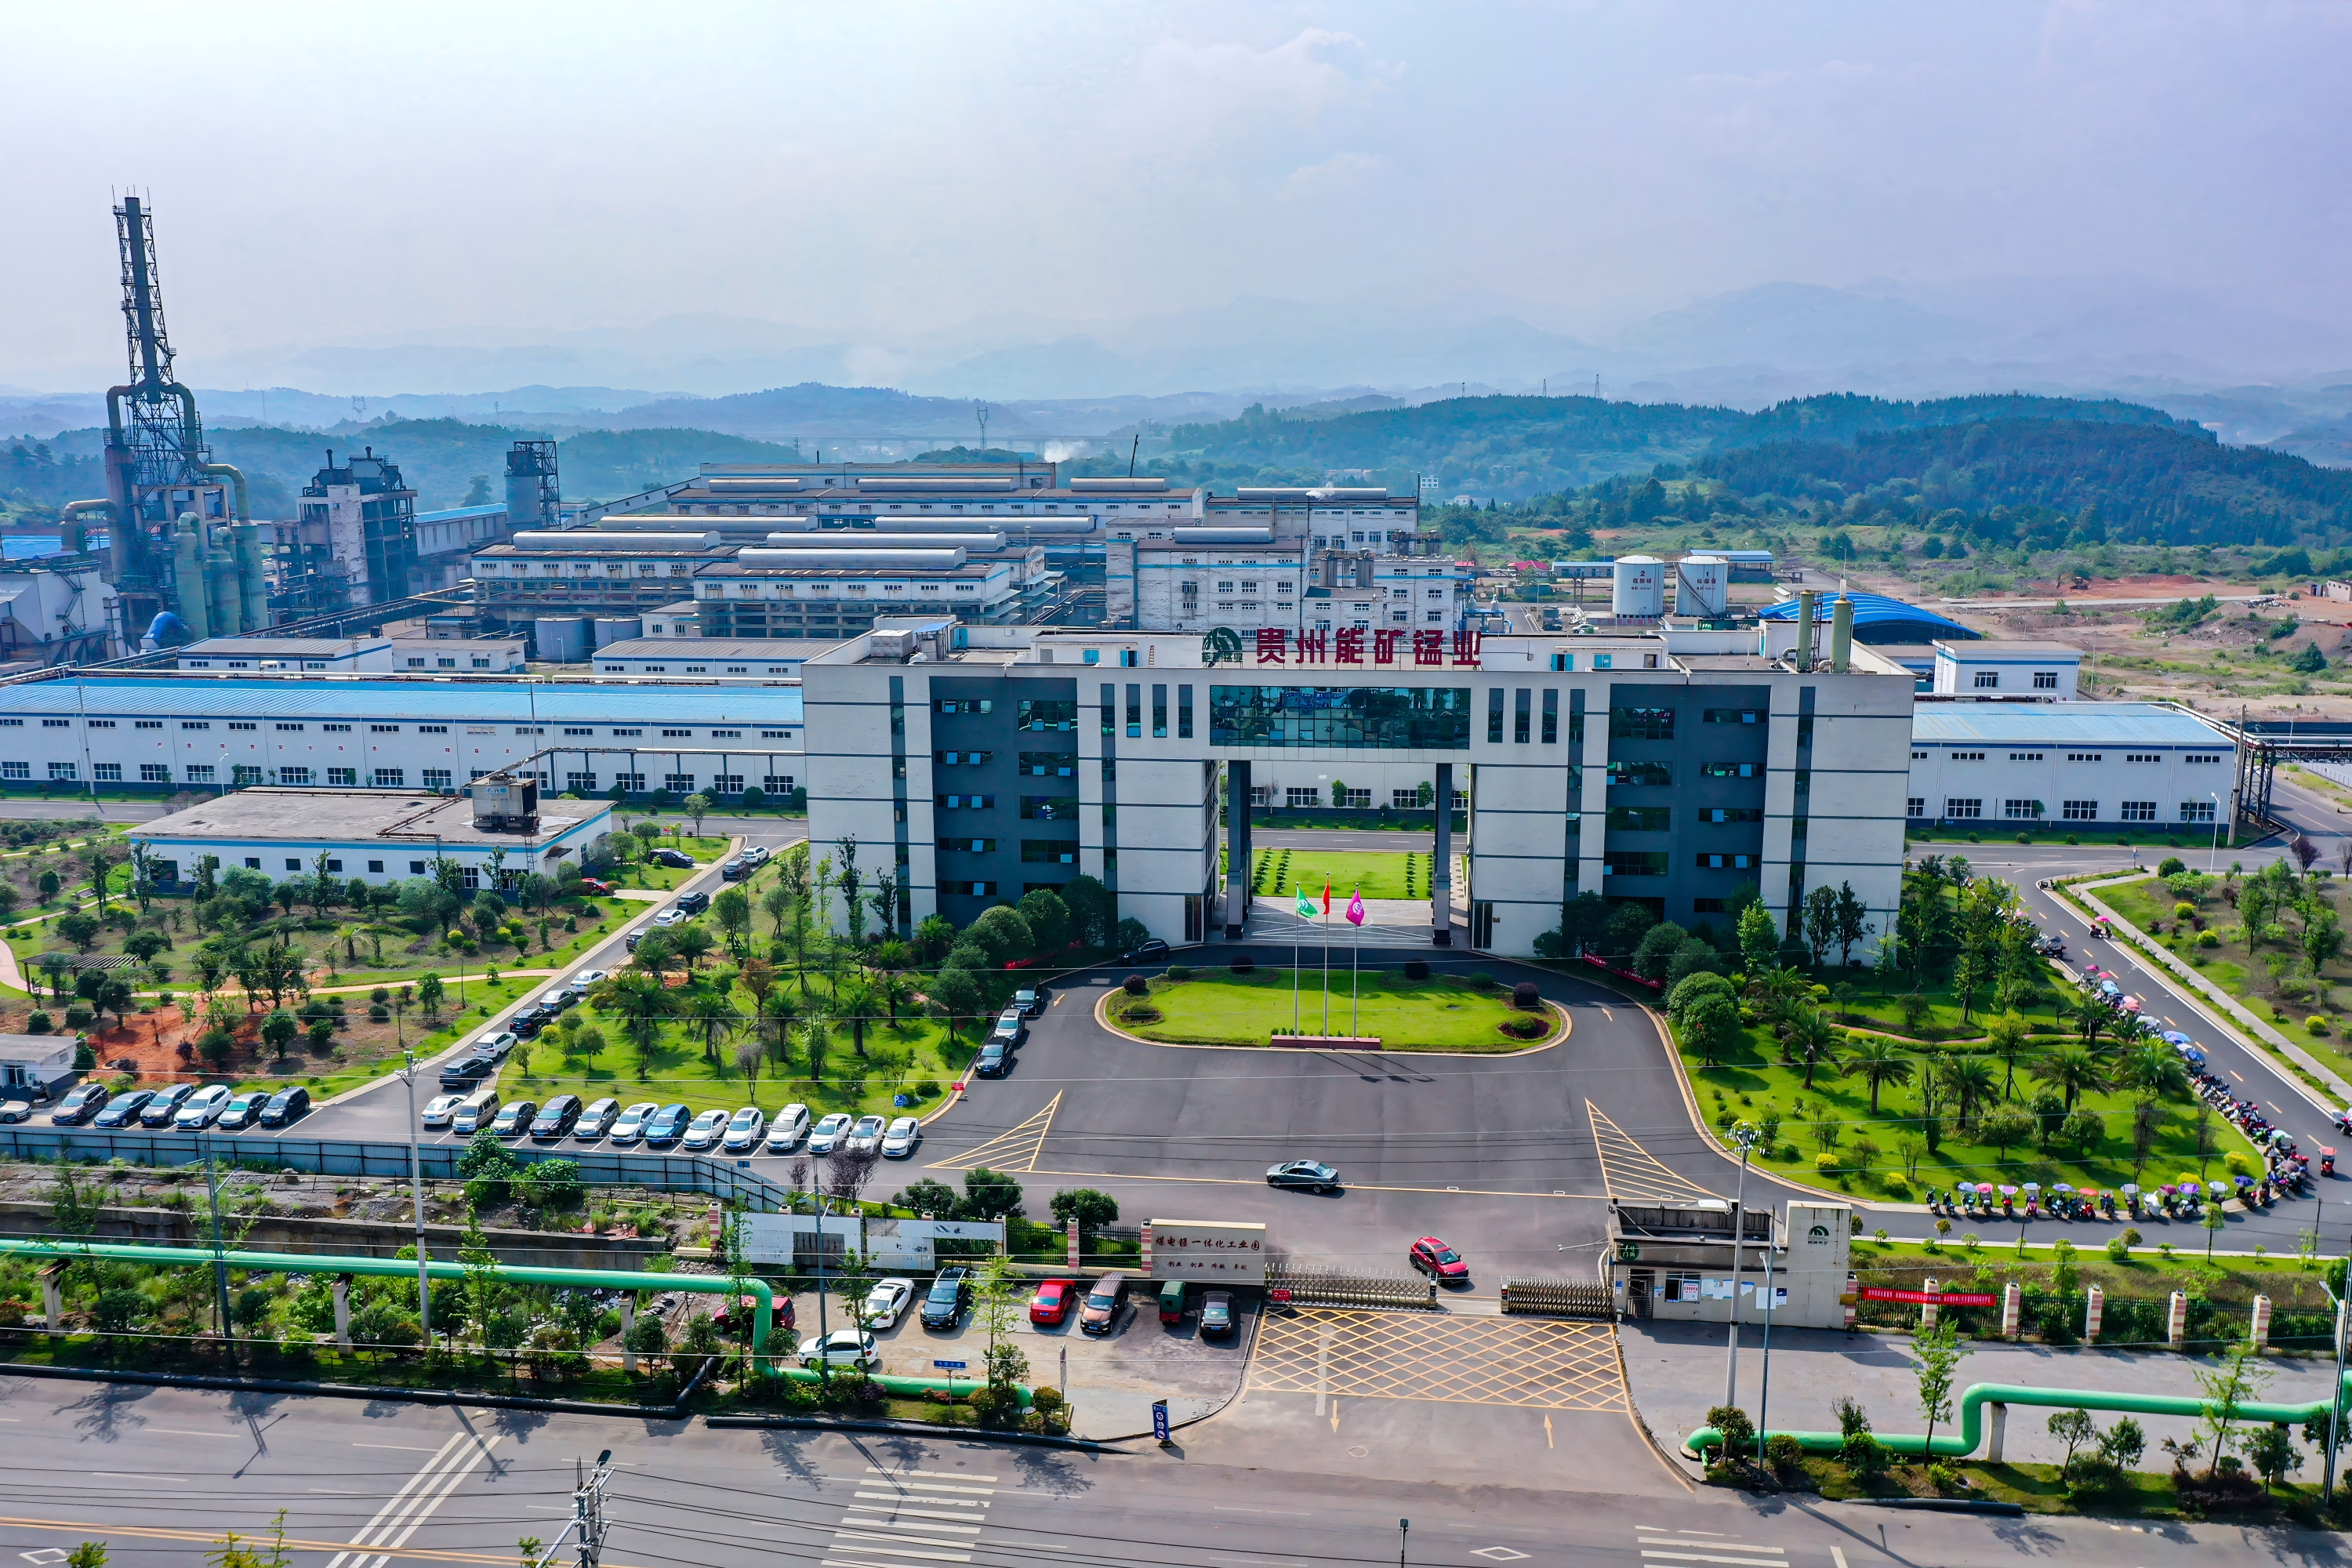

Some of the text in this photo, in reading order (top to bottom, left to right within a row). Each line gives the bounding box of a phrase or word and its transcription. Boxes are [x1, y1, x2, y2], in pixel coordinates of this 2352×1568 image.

[1257, 627, 1481, 666] 贵州能矿锰业
